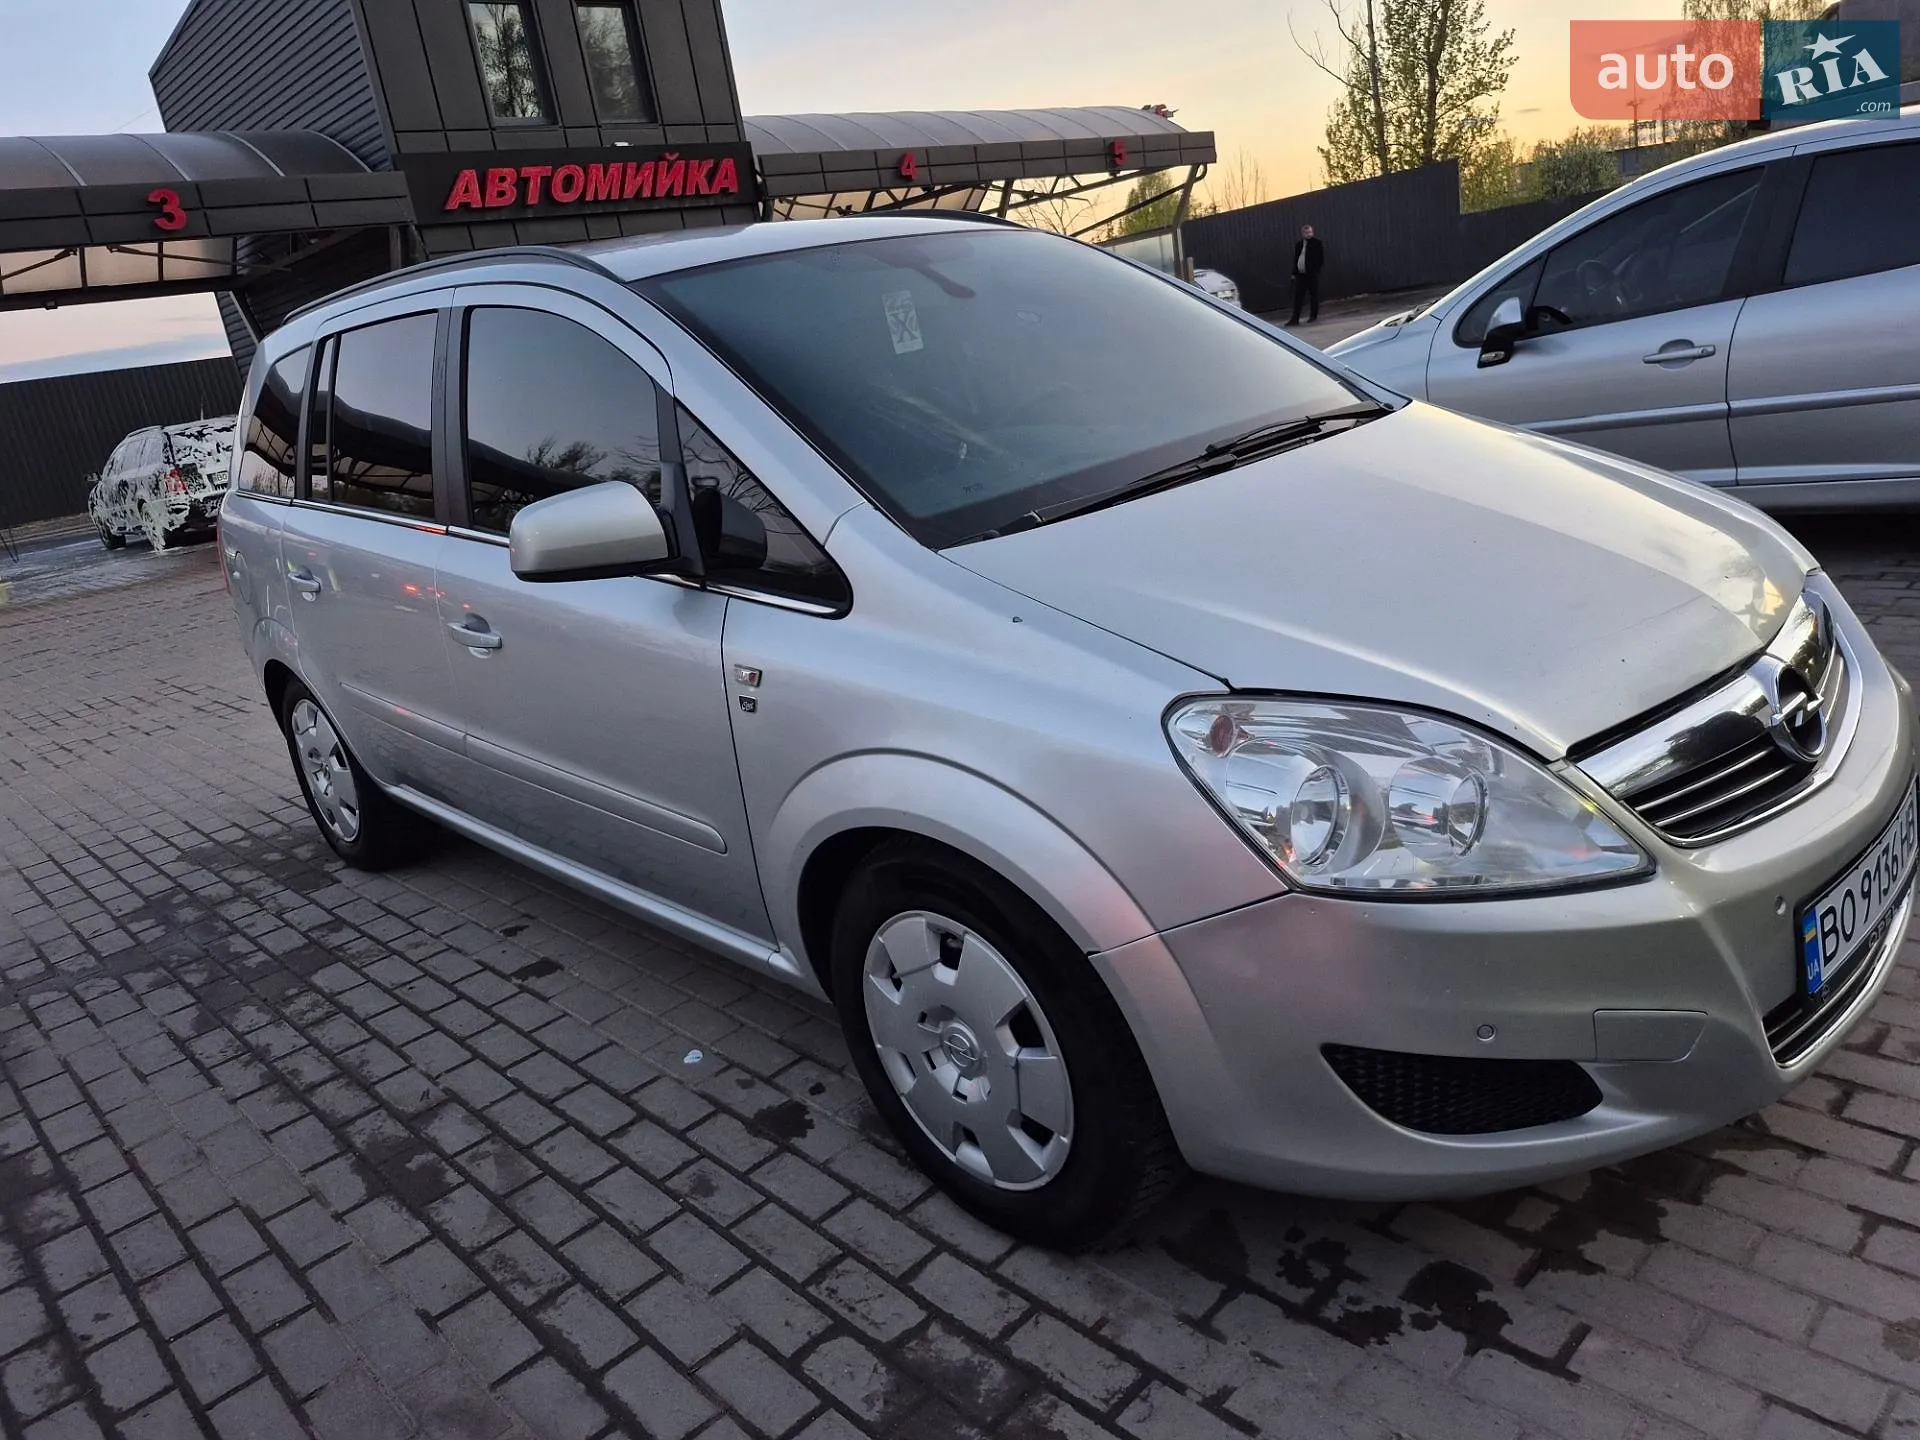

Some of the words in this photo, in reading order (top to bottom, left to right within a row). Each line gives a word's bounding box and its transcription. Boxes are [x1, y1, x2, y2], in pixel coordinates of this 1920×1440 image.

[900, 152, 918, 181] 4
[1113, 140, 1127, 166] 5
[445, 152, 738, 210] АВТОМИЙКА
[147, 188, 187, 231] 3
[1819, 887, 1856, 968] BO
[1861, 831, 1899, 924] 9136
[1807, 962, 1819, 980] UA
